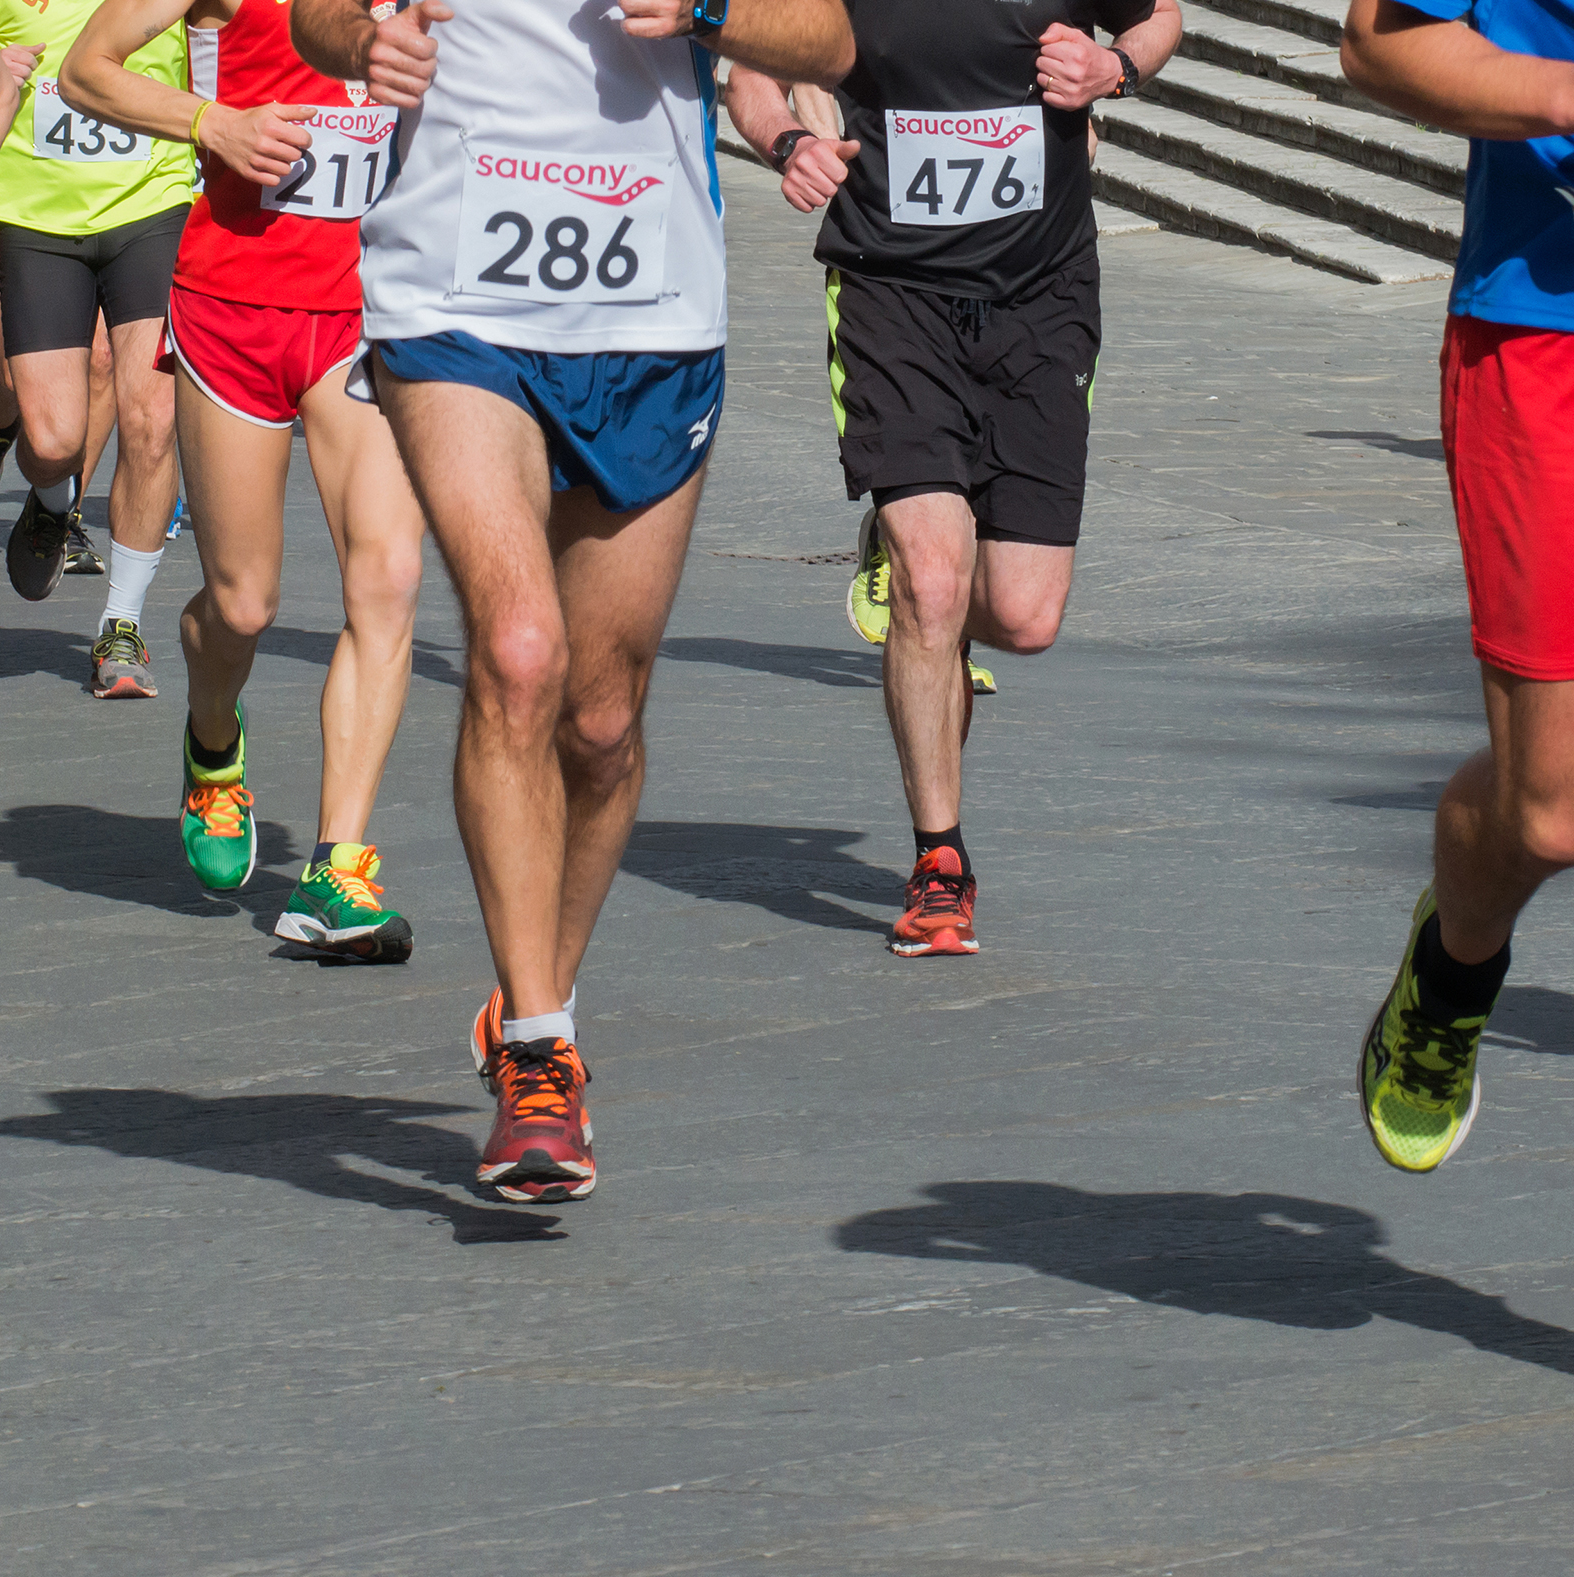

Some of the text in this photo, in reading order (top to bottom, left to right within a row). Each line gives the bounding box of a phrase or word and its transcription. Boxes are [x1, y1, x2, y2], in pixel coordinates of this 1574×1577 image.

[290, 112, 381, 134] ucony
[894, 114, 1005, 138] saucony
[275, 148, 381, 208] 211
[476, 154, 628, 192] saucony
[906, 154, 1026, 216] 476
[477, 211, 639, 291] 286
